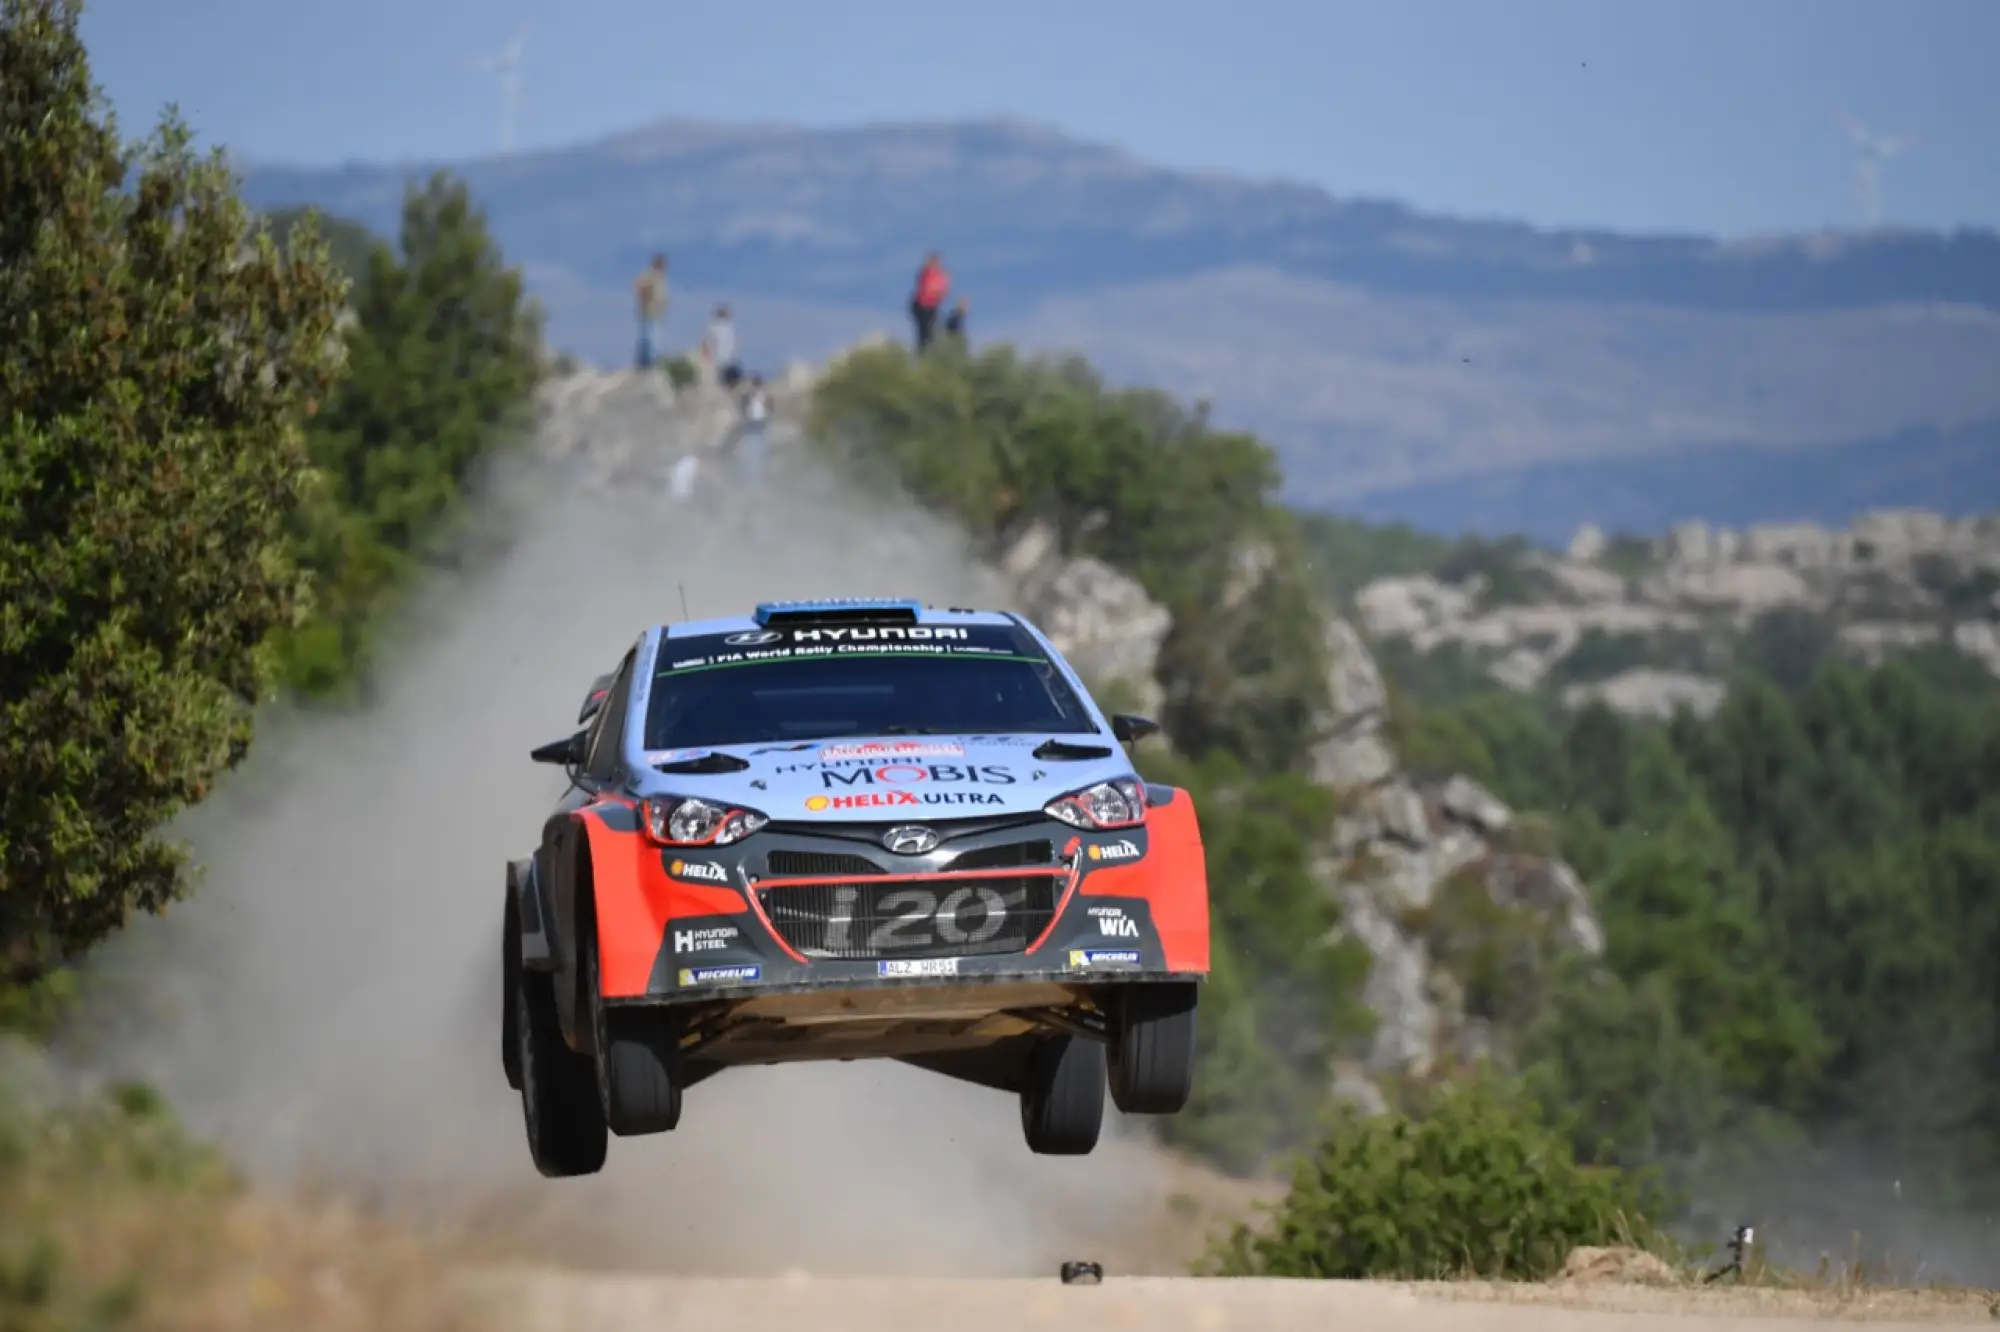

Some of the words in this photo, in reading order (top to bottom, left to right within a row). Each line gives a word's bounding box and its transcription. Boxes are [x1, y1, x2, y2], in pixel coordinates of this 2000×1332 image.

[793, 627, 968, 642] HYUNDAI
[717, 651, 743, 664] FIA
[746, 648, 791, 660] World
[795, 645, 834, 656] Rally
[837, 643, 945, 654] Championship
[820, 764, 1016, 788] MOBIS
[832, 790, 919, 810] HELIX
[922, 792, 1005, 806] ULTRA
[1101, 839, 1140, 859] HELIX
[682, 860, 728, 881] HELIX
[695, 927, 738, 939] HYUNDAI
[695, 940, 727, 951] STEEL
[1090, 951, 1138, 962] MICHELIN
[697, 967, 757, 981] MICHELIN
